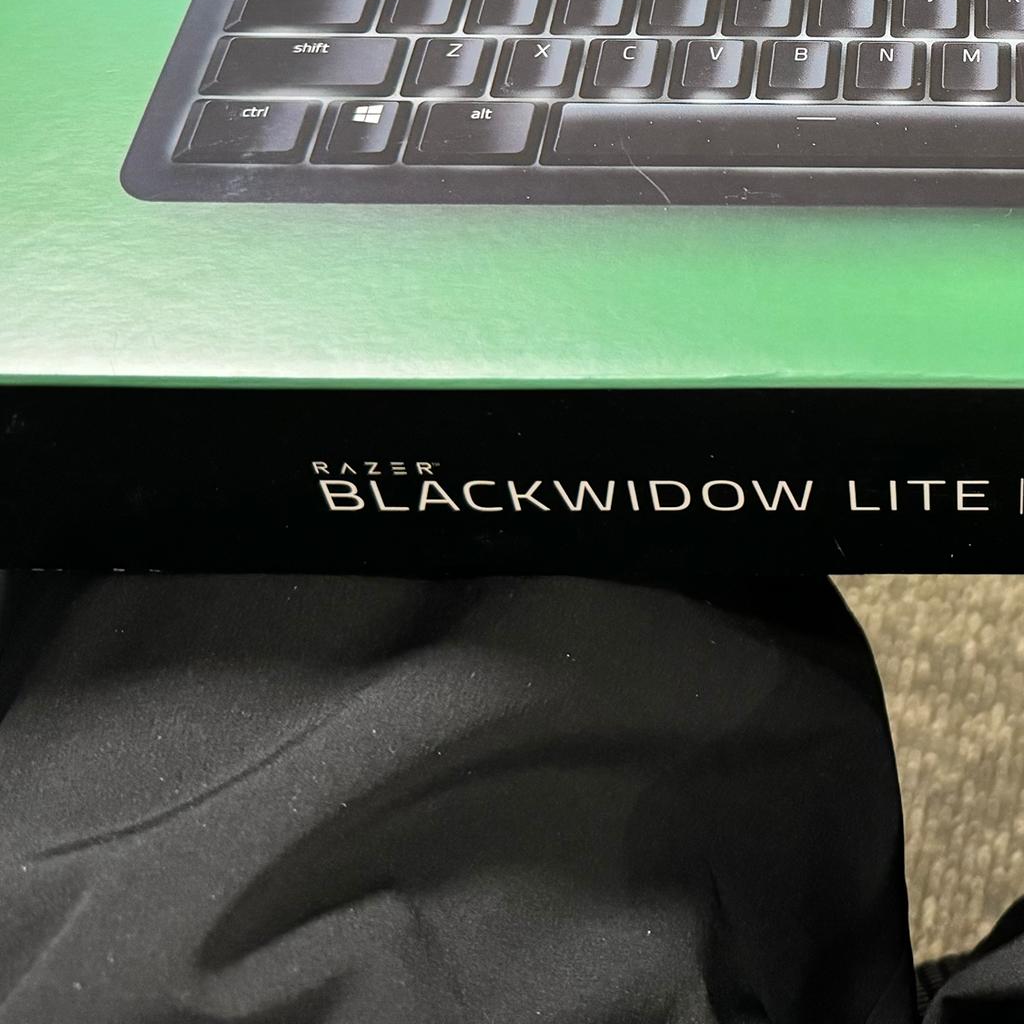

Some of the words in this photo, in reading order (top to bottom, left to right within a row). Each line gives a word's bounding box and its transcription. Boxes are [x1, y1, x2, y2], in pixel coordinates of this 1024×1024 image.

[292, 42, 330, 54] shift
[446, 43, 463, 57] Z
[534, 44, 551, 58] X
[623, 46, 637, 60] C
[709, 46, 724, 60] V
[794, 47, 808, 61] B
[879, 48, 894, 62] N
[963, 49, 981, 63] M
[242, 106, 268, 118] ctrl
[471, 107, 493, 119] alt
[312, 461, 434, 475] RAZER
[319, 480, 813, 512] BLACKWIDOW
[848, 479, 990, 512] LITE
